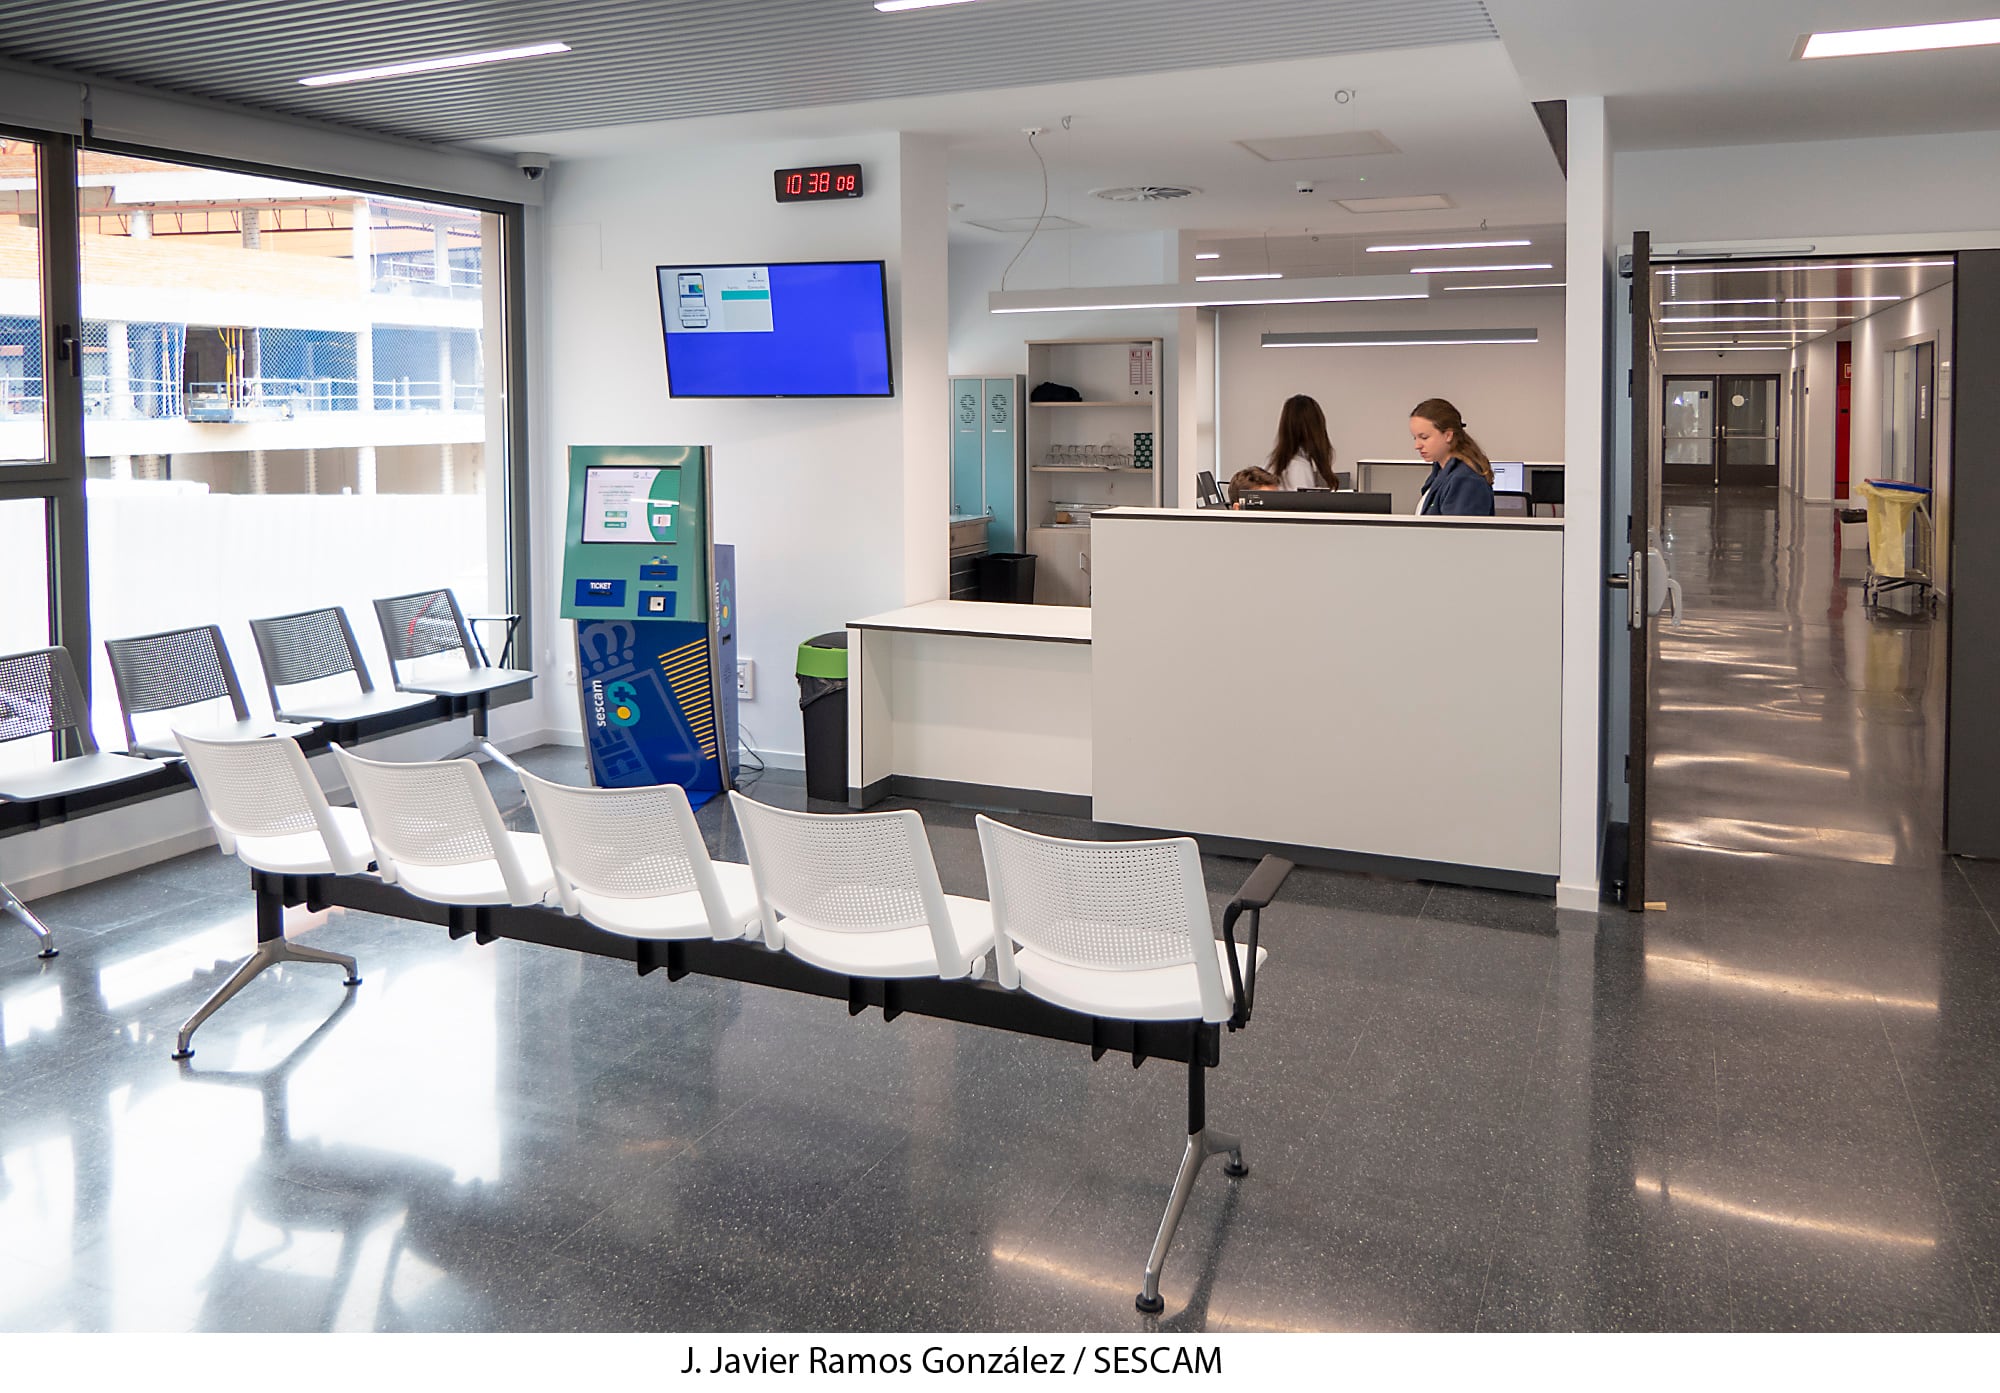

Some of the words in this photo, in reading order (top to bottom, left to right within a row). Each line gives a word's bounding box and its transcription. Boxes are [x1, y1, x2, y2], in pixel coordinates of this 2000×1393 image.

[786, 174, 802, 194] 10
[808, 172, 830, 193] 38
[836, 175, 855, 191] 08
[590, 582, 612, 590] TICKET
[592, 680, 606, 727] sescam
